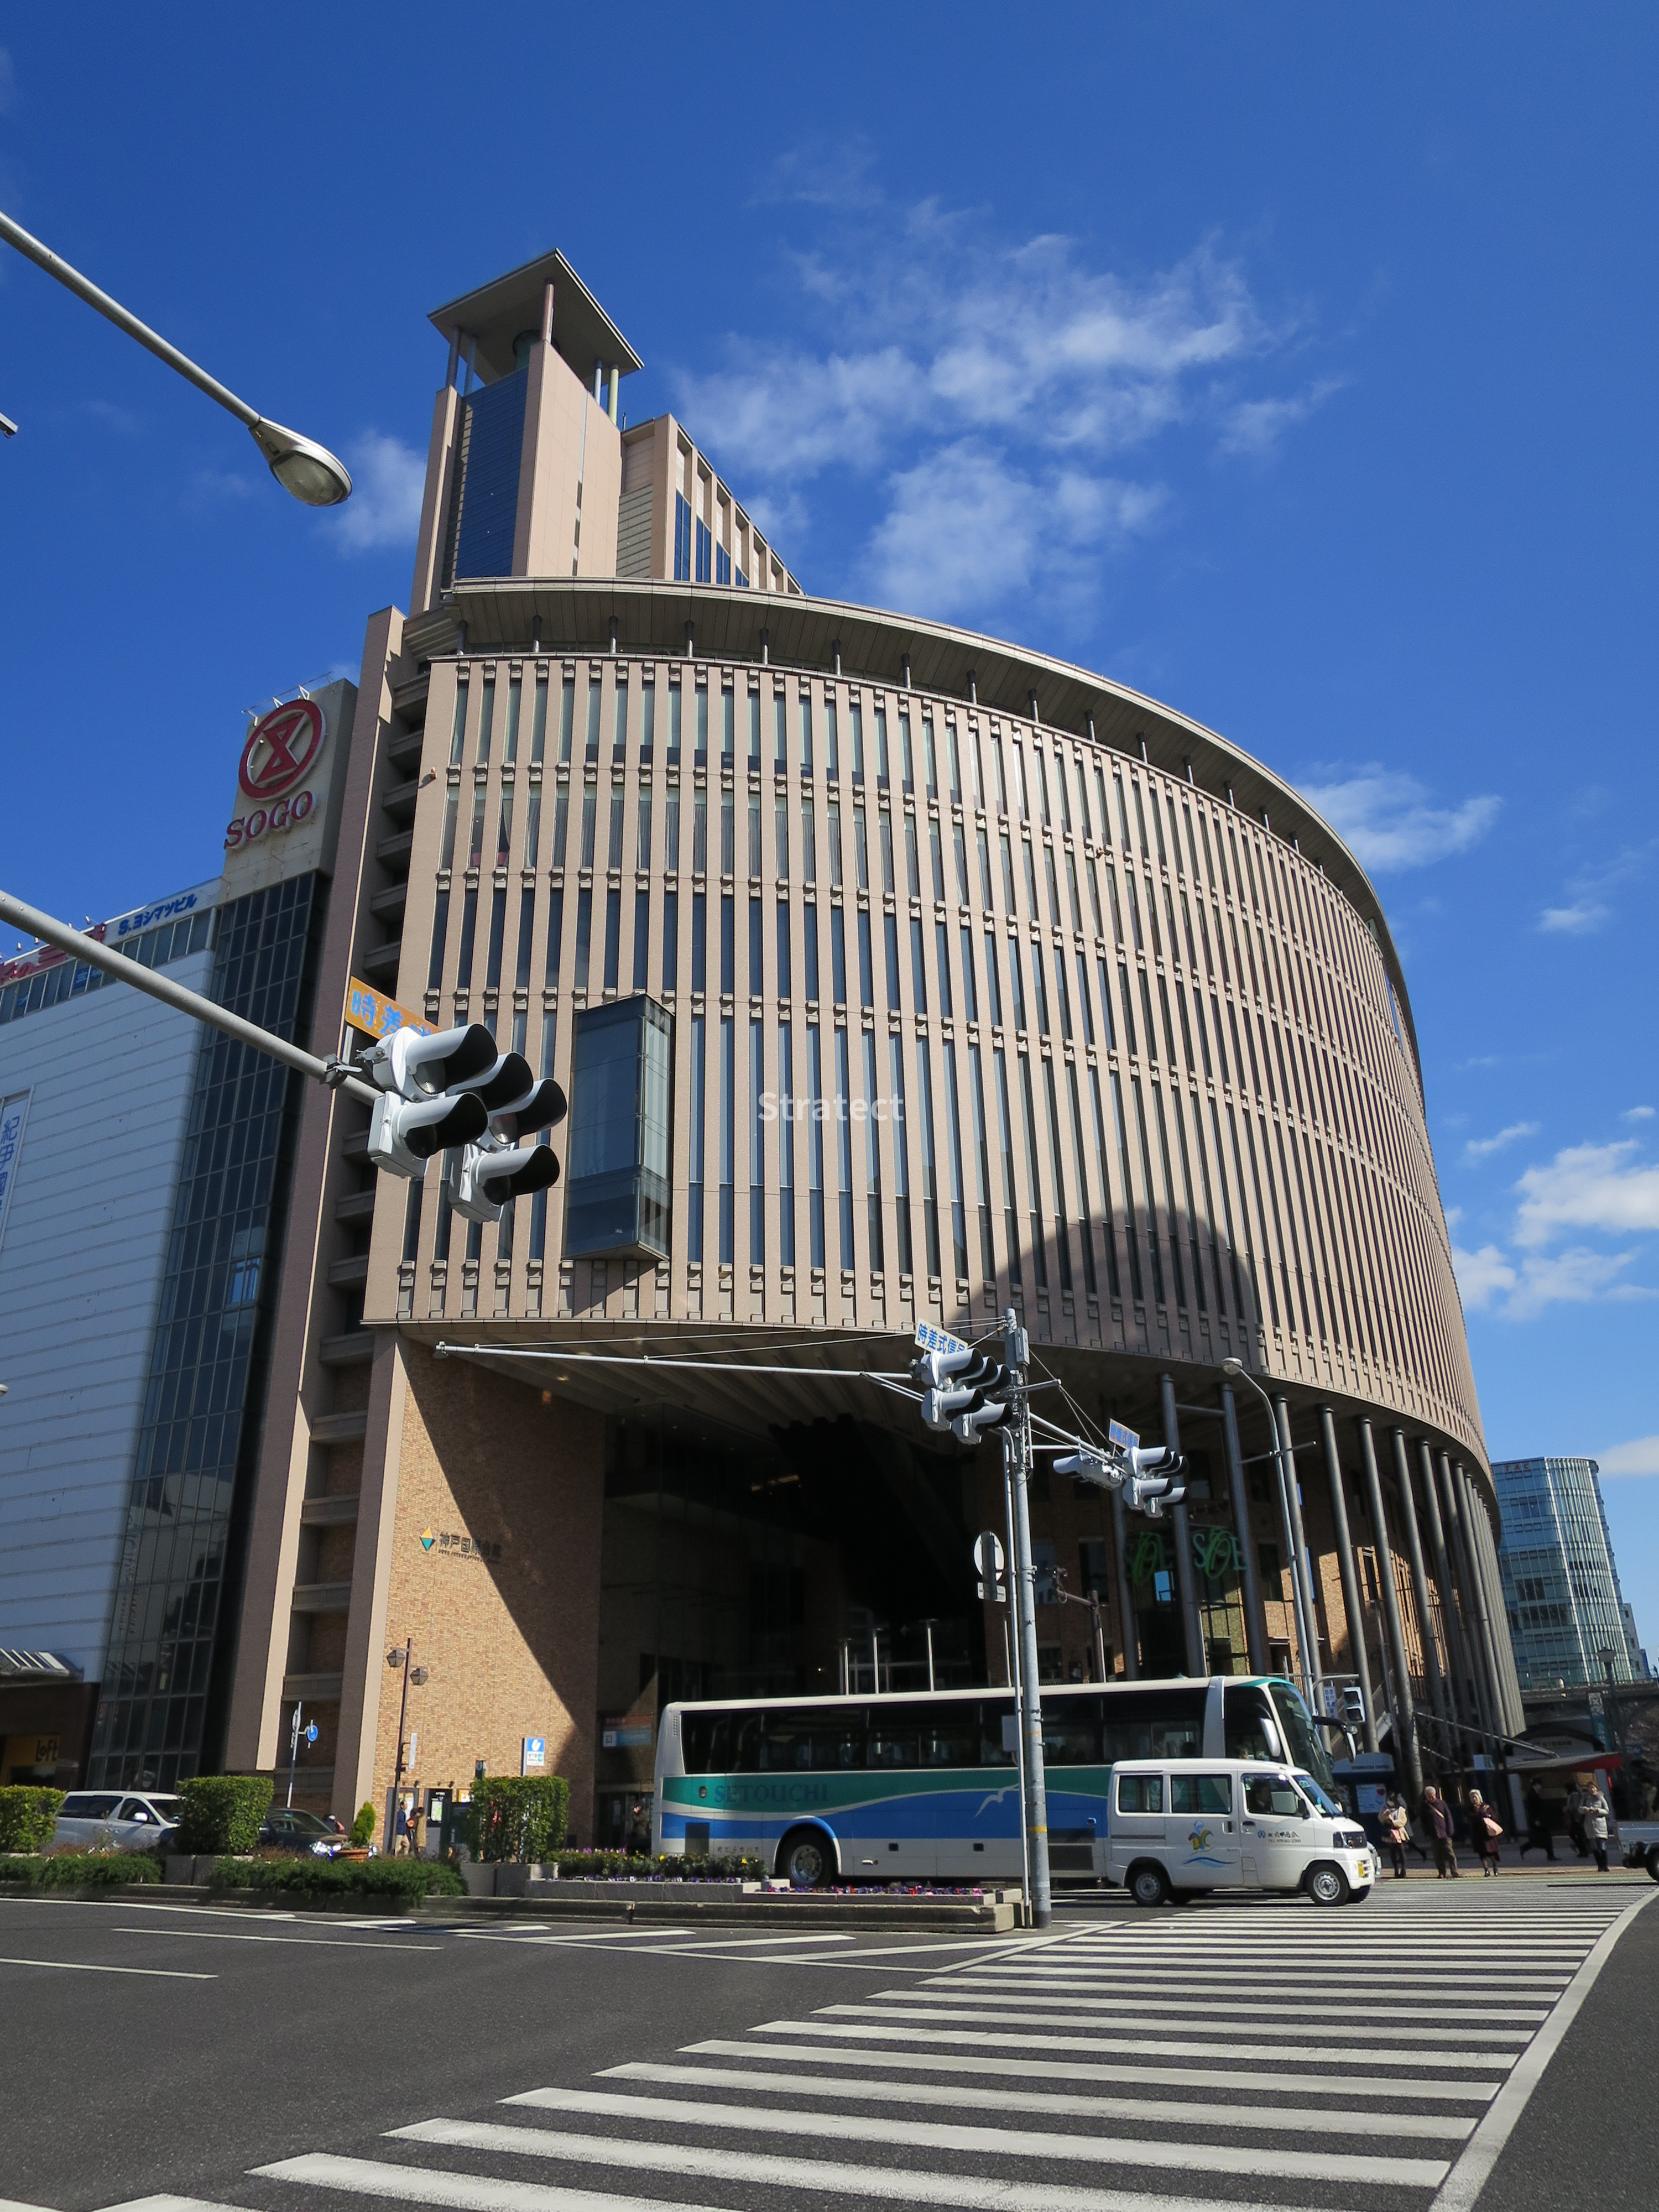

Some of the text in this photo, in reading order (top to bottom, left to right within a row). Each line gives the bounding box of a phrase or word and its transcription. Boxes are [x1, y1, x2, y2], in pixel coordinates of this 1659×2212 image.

[224, 791, 315, 849] SOGO
[1504, 1462, 1529, 1472] TAC
[35, 1739, 58, 1762] Loft
[714, 1784, 828, 1803] SETOUCHI
